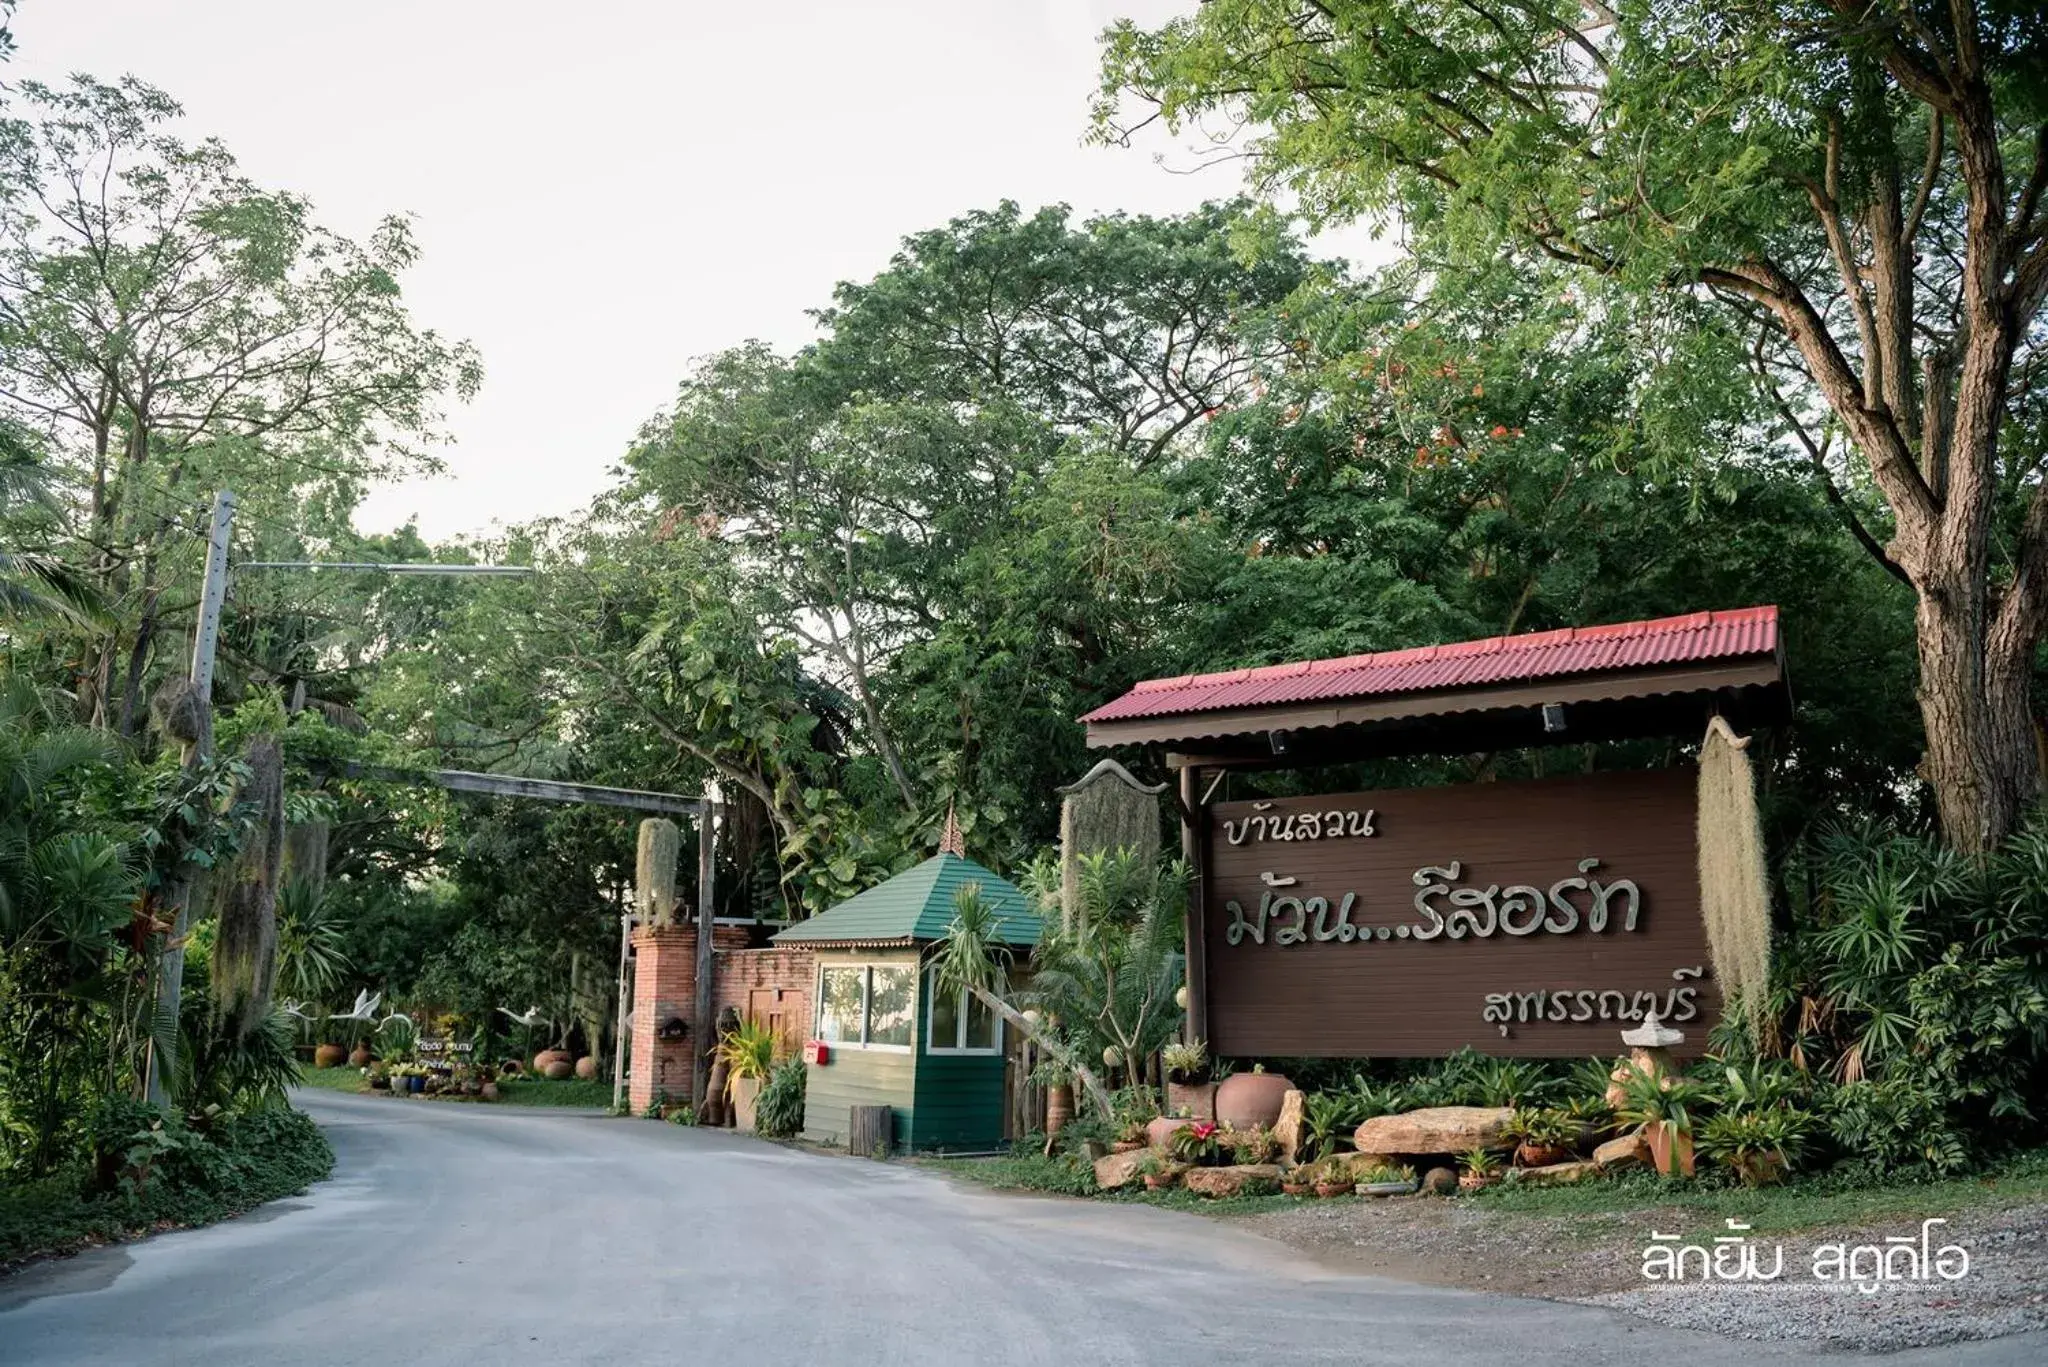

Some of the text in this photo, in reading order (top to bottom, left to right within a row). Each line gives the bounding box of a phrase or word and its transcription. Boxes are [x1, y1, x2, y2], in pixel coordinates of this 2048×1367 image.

[1222, 802, 1375, 845] บ้านสวน
[1482, 965, 1703, 1038] สุพรรณบรี
